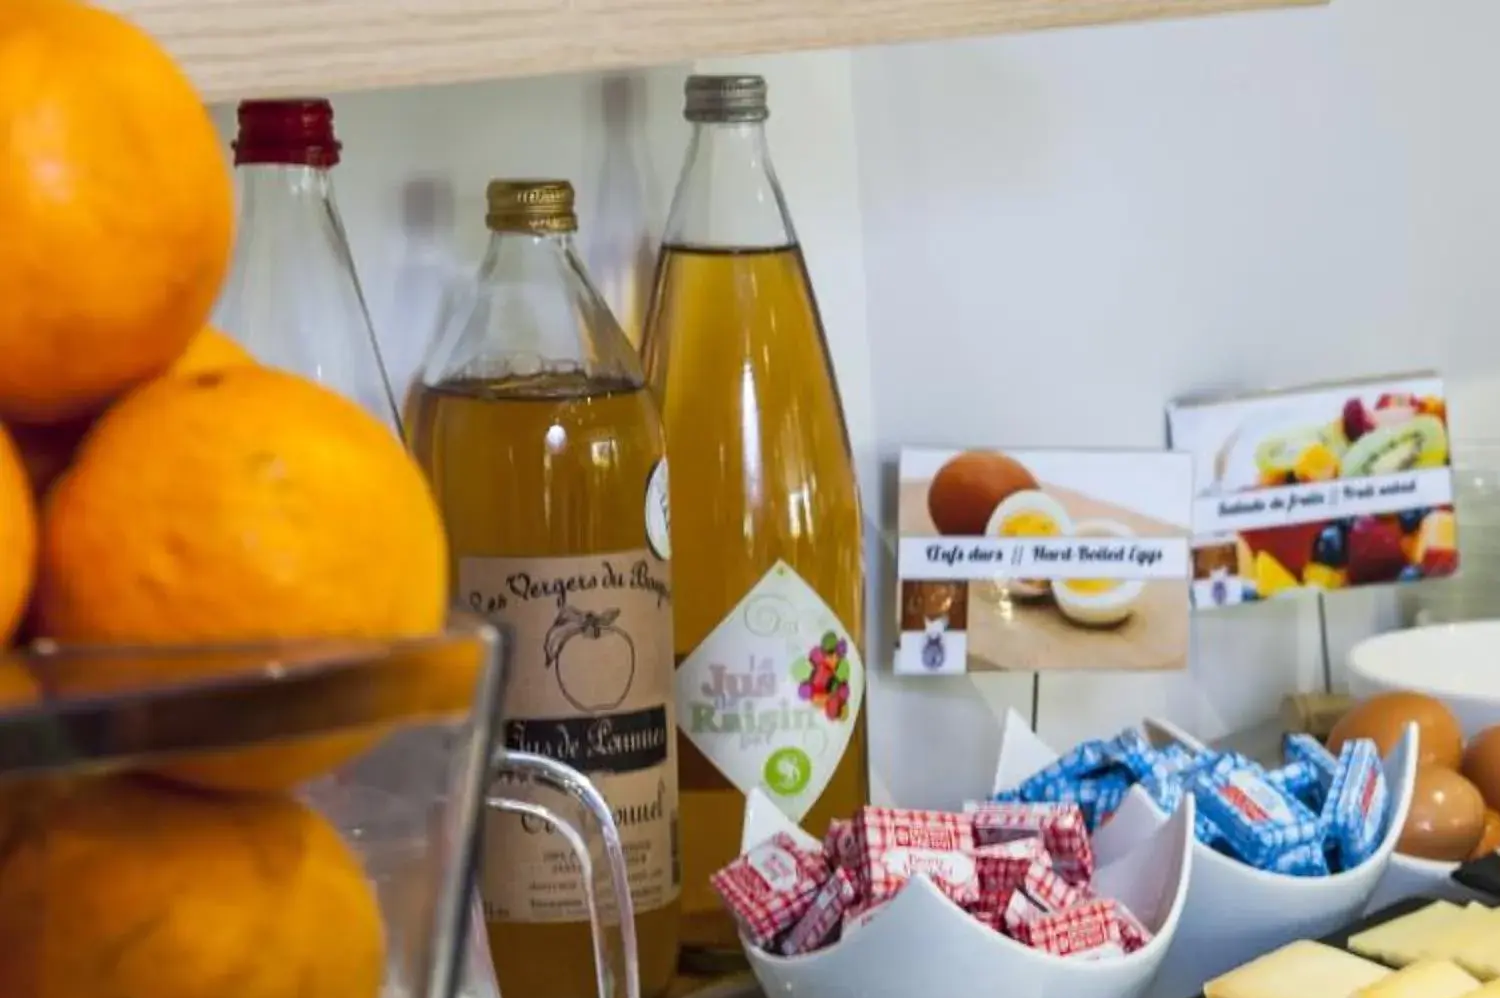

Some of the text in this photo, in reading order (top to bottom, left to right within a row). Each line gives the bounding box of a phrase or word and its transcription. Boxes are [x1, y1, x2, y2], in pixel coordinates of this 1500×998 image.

[968, 545, 1004, 562] durs
[1129, 546, 1163, 566] Eggs
[506, 572, 598, 608] Vergers
[601, 561, 624, 588] du
[701, 664, 776, 698] Jus
[690, 696, 818, 733] Raisin
